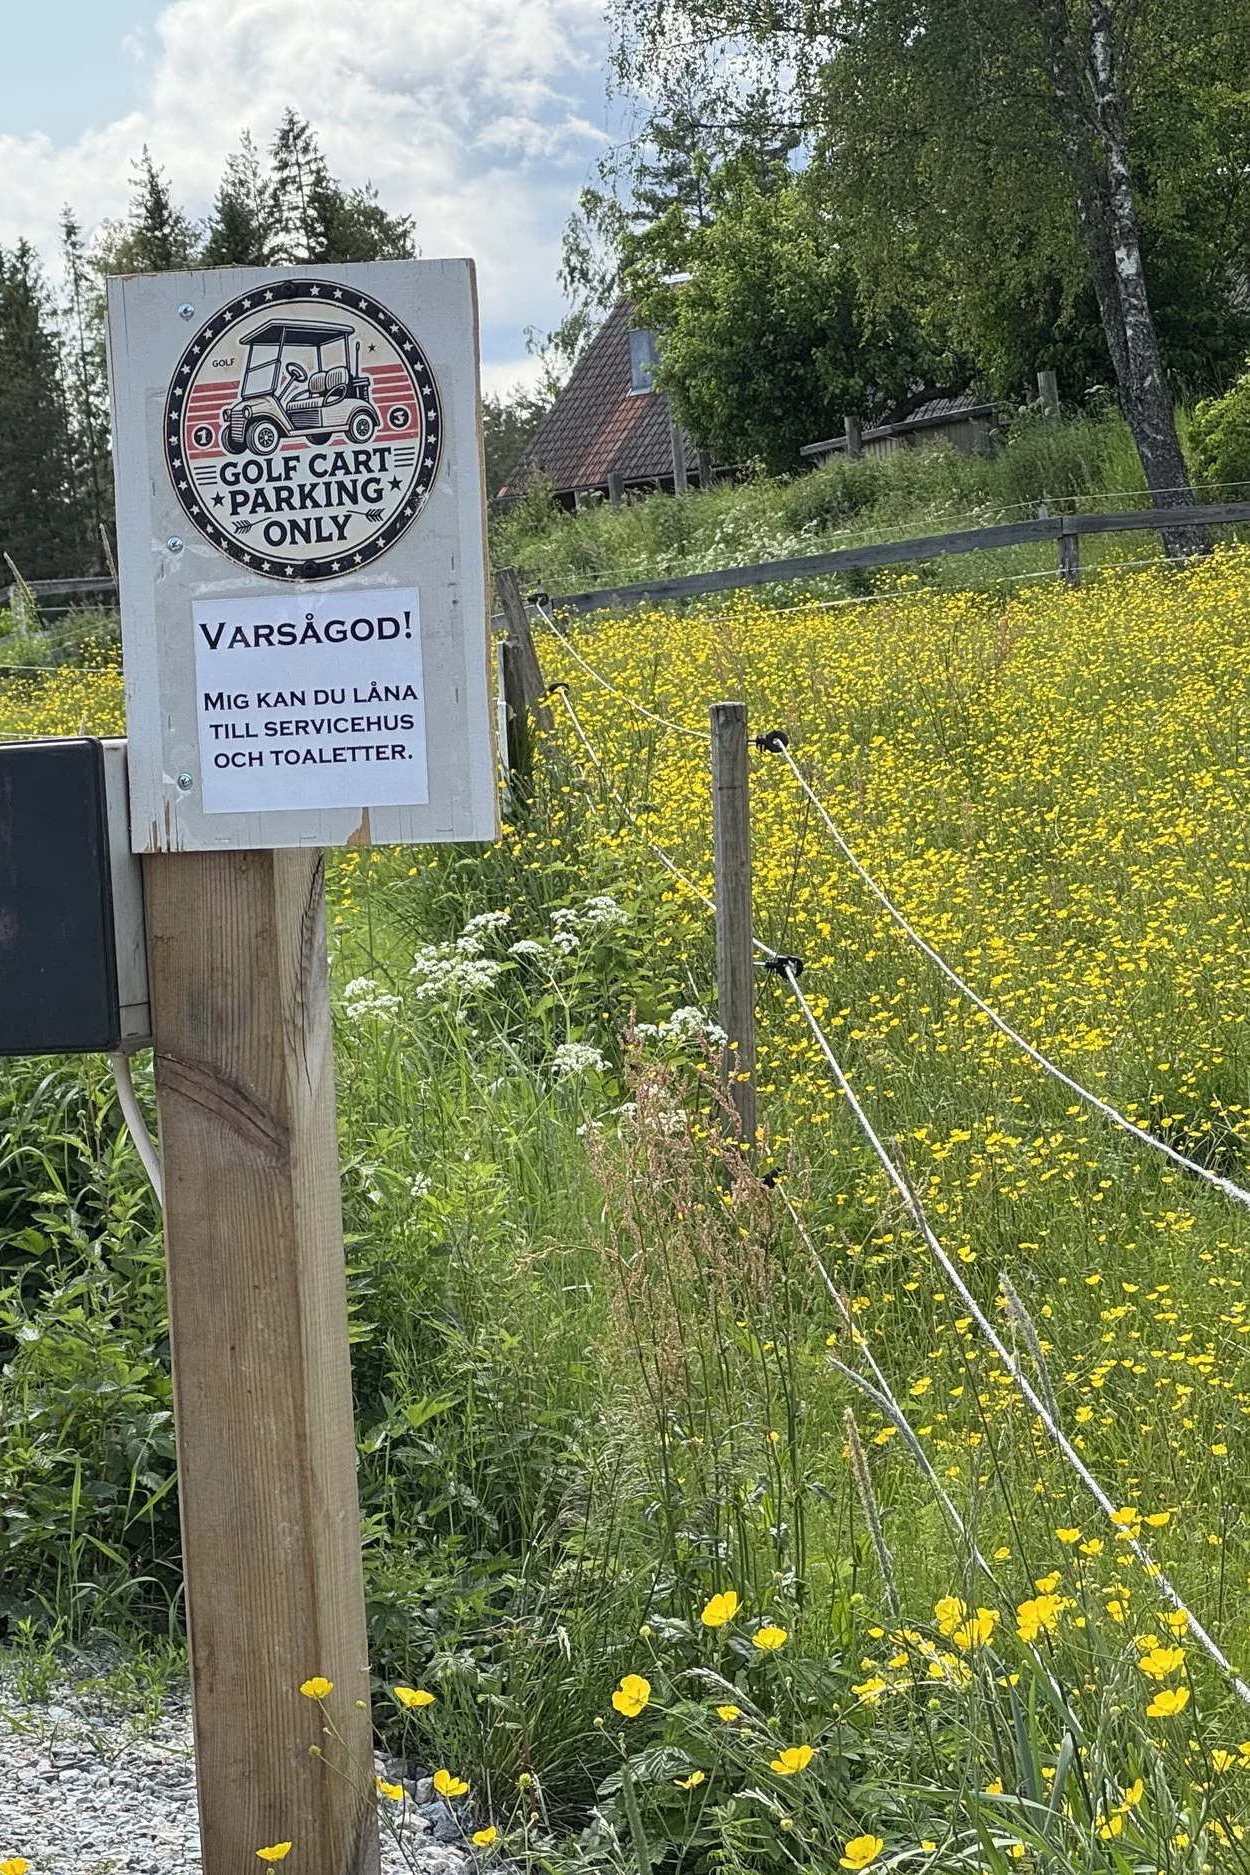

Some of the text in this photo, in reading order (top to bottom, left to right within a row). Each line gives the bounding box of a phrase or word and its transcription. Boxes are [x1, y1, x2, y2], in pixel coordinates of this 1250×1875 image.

[212, 358, 236, 368] GOLF
[219, 447, 392, 486] GOLF CART
[228, 477, 384, 516] PARKING
[263, 514, 352, 547] ONLY
[199, 611, 412, 650] VARSÅGOD!
[204, 681, 418, 711] MIG KAN DU LÅNA
[210, 714, 414, 739] TILL SERVICEHUS
[214, 744, 413, 769] OCH TOALETTER.
